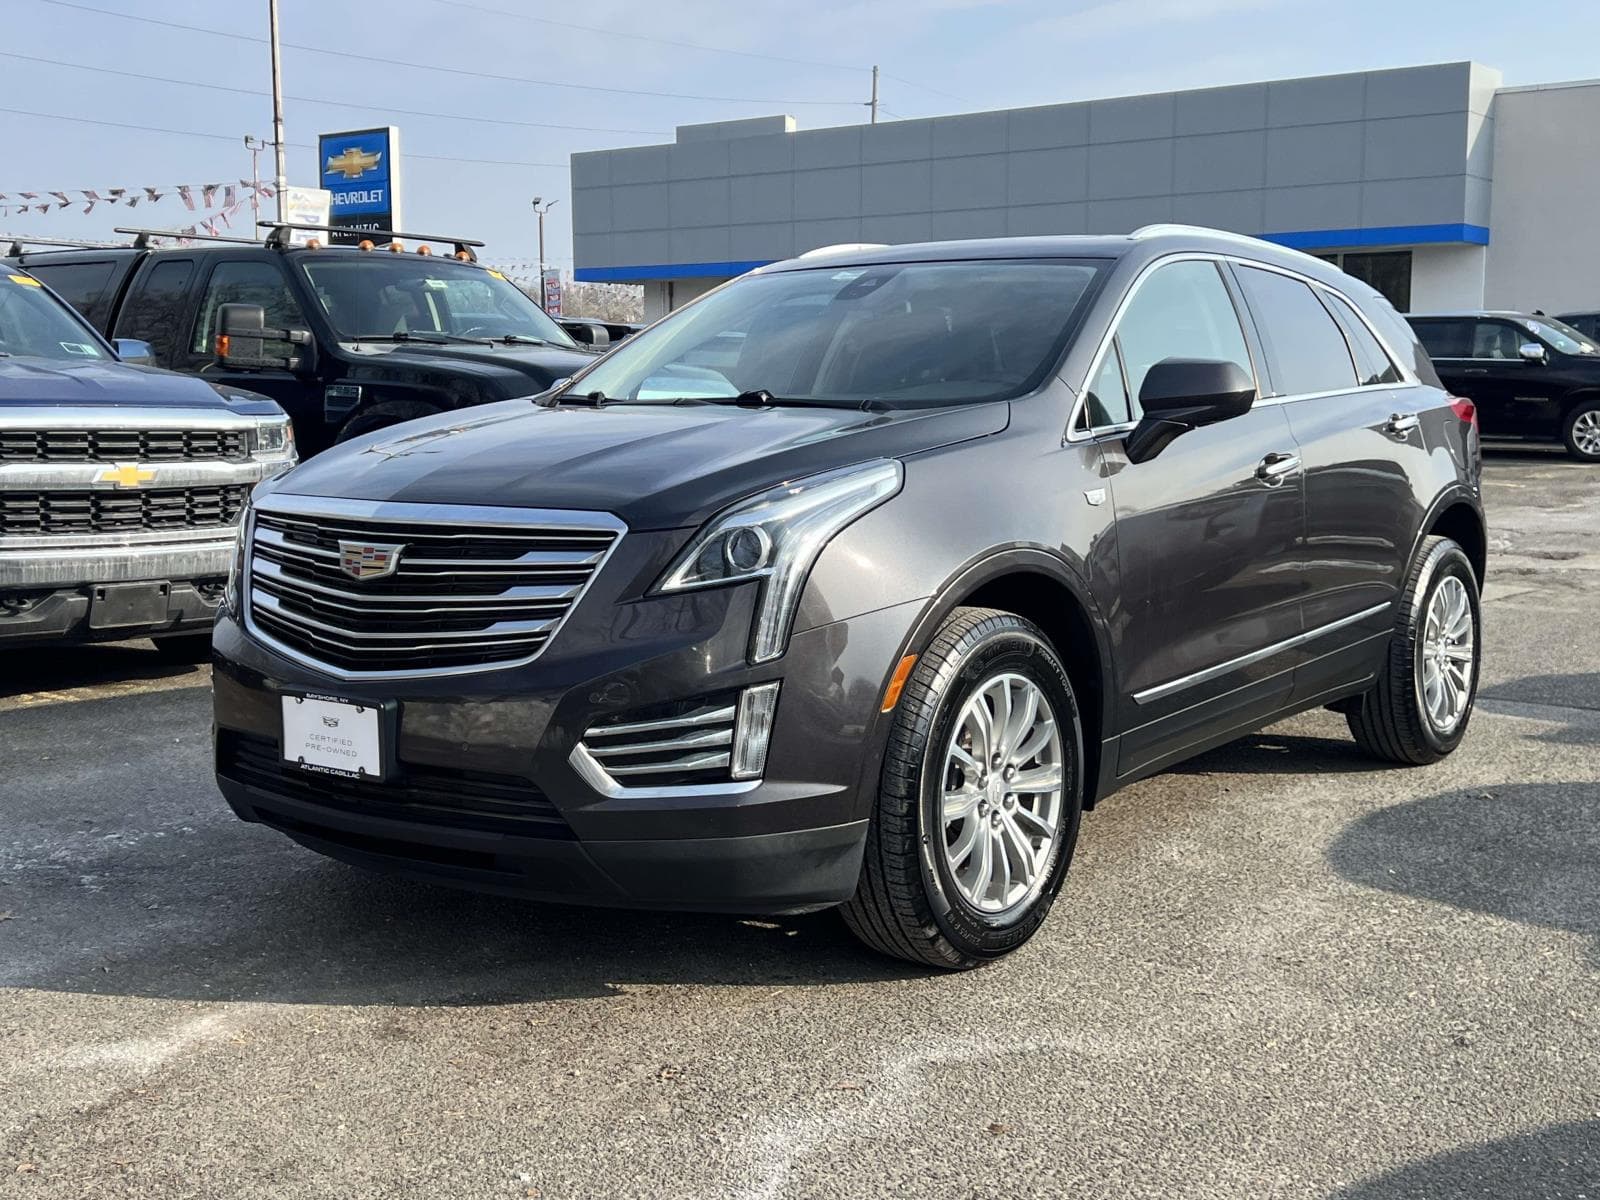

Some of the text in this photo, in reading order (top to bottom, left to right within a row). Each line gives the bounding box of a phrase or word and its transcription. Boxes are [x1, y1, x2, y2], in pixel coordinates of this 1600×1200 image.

[330, 189, 384, 206] HEVROLET
[309, 733, 353, 747] CERTIFIED
[305, 742, 358, 758] PRE-OWNED
[300, 763, 361, 779] ATLANTIC CADILLAC
